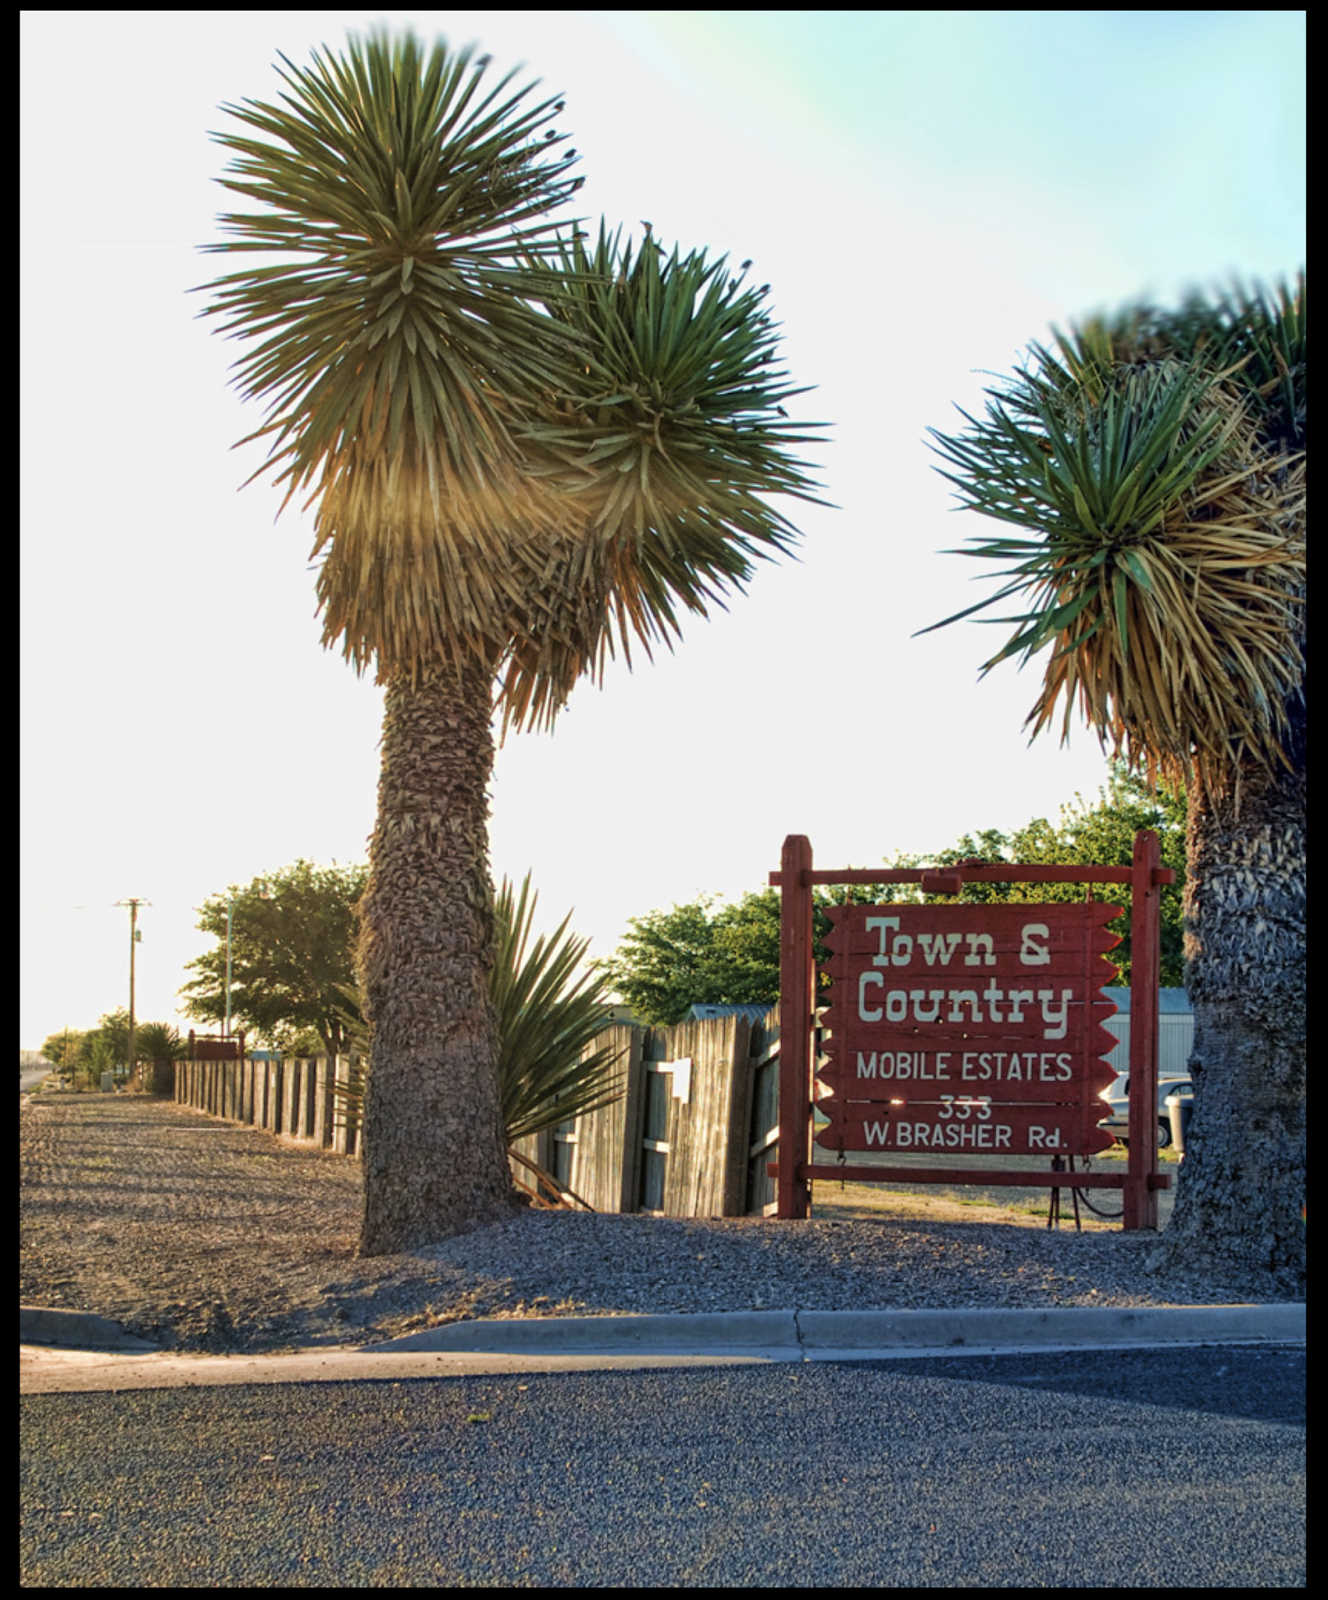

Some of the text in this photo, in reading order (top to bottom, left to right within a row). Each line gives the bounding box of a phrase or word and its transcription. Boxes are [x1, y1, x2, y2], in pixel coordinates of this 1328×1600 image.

[865, 917, 1051, 967] Town &
[858, 971, 1074, 1040] Country
[856, 1052, 1073, 1081] MOBILE ESTATES
[938, 1095, 992, 1120] 333
[1028, 1126, 1068, 1148] Rd.
